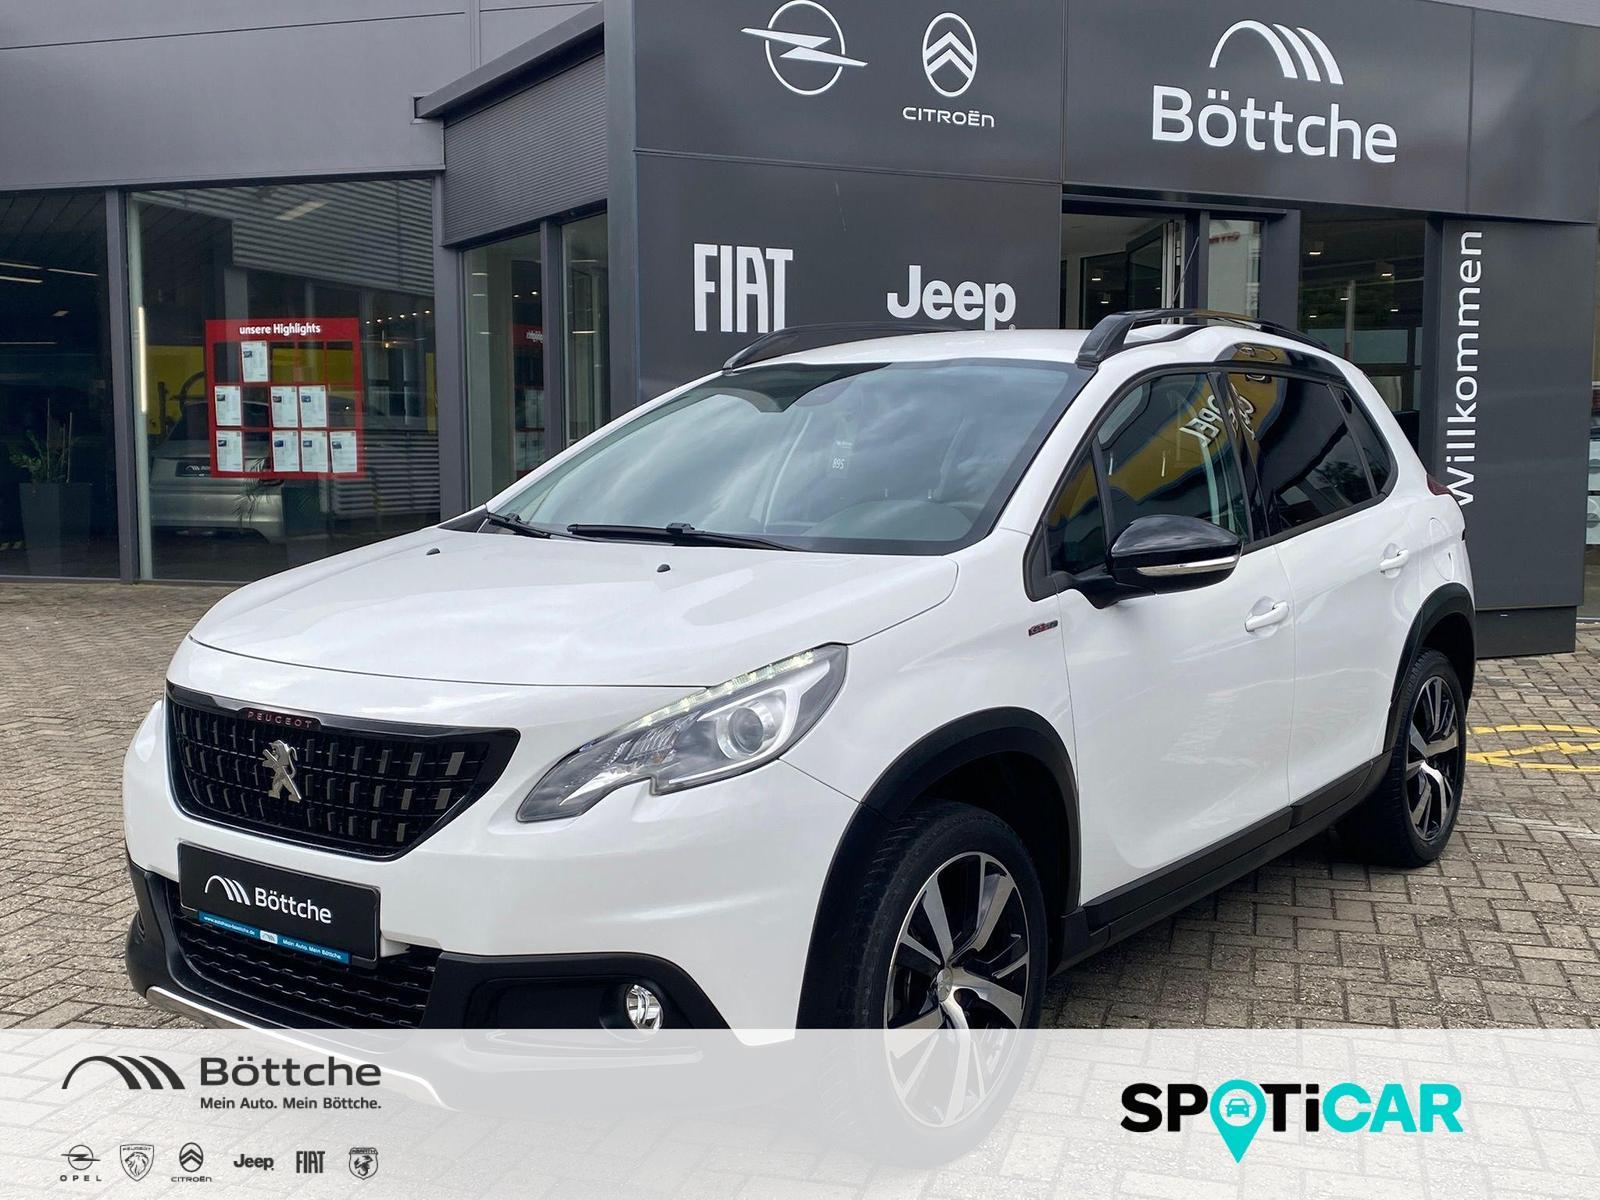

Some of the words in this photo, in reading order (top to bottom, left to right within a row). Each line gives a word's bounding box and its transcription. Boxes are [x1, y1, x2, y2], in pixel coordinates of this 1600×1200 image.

[902, 107, 995, 128] CITROËN
[1152, 85, 1398, 163] Böttche
[694, 243, 793, 333] FIAT
[887, 265, 1016, 331] Jeep
[240, 326, 271, 335] unsere
[273, 322, 321, 336] Highlights
[1446, 231, 1482, 506] Willkommen
[247, 711, 312, 729] PEUGEOT
[255, 887, 332, 924] Böttche
